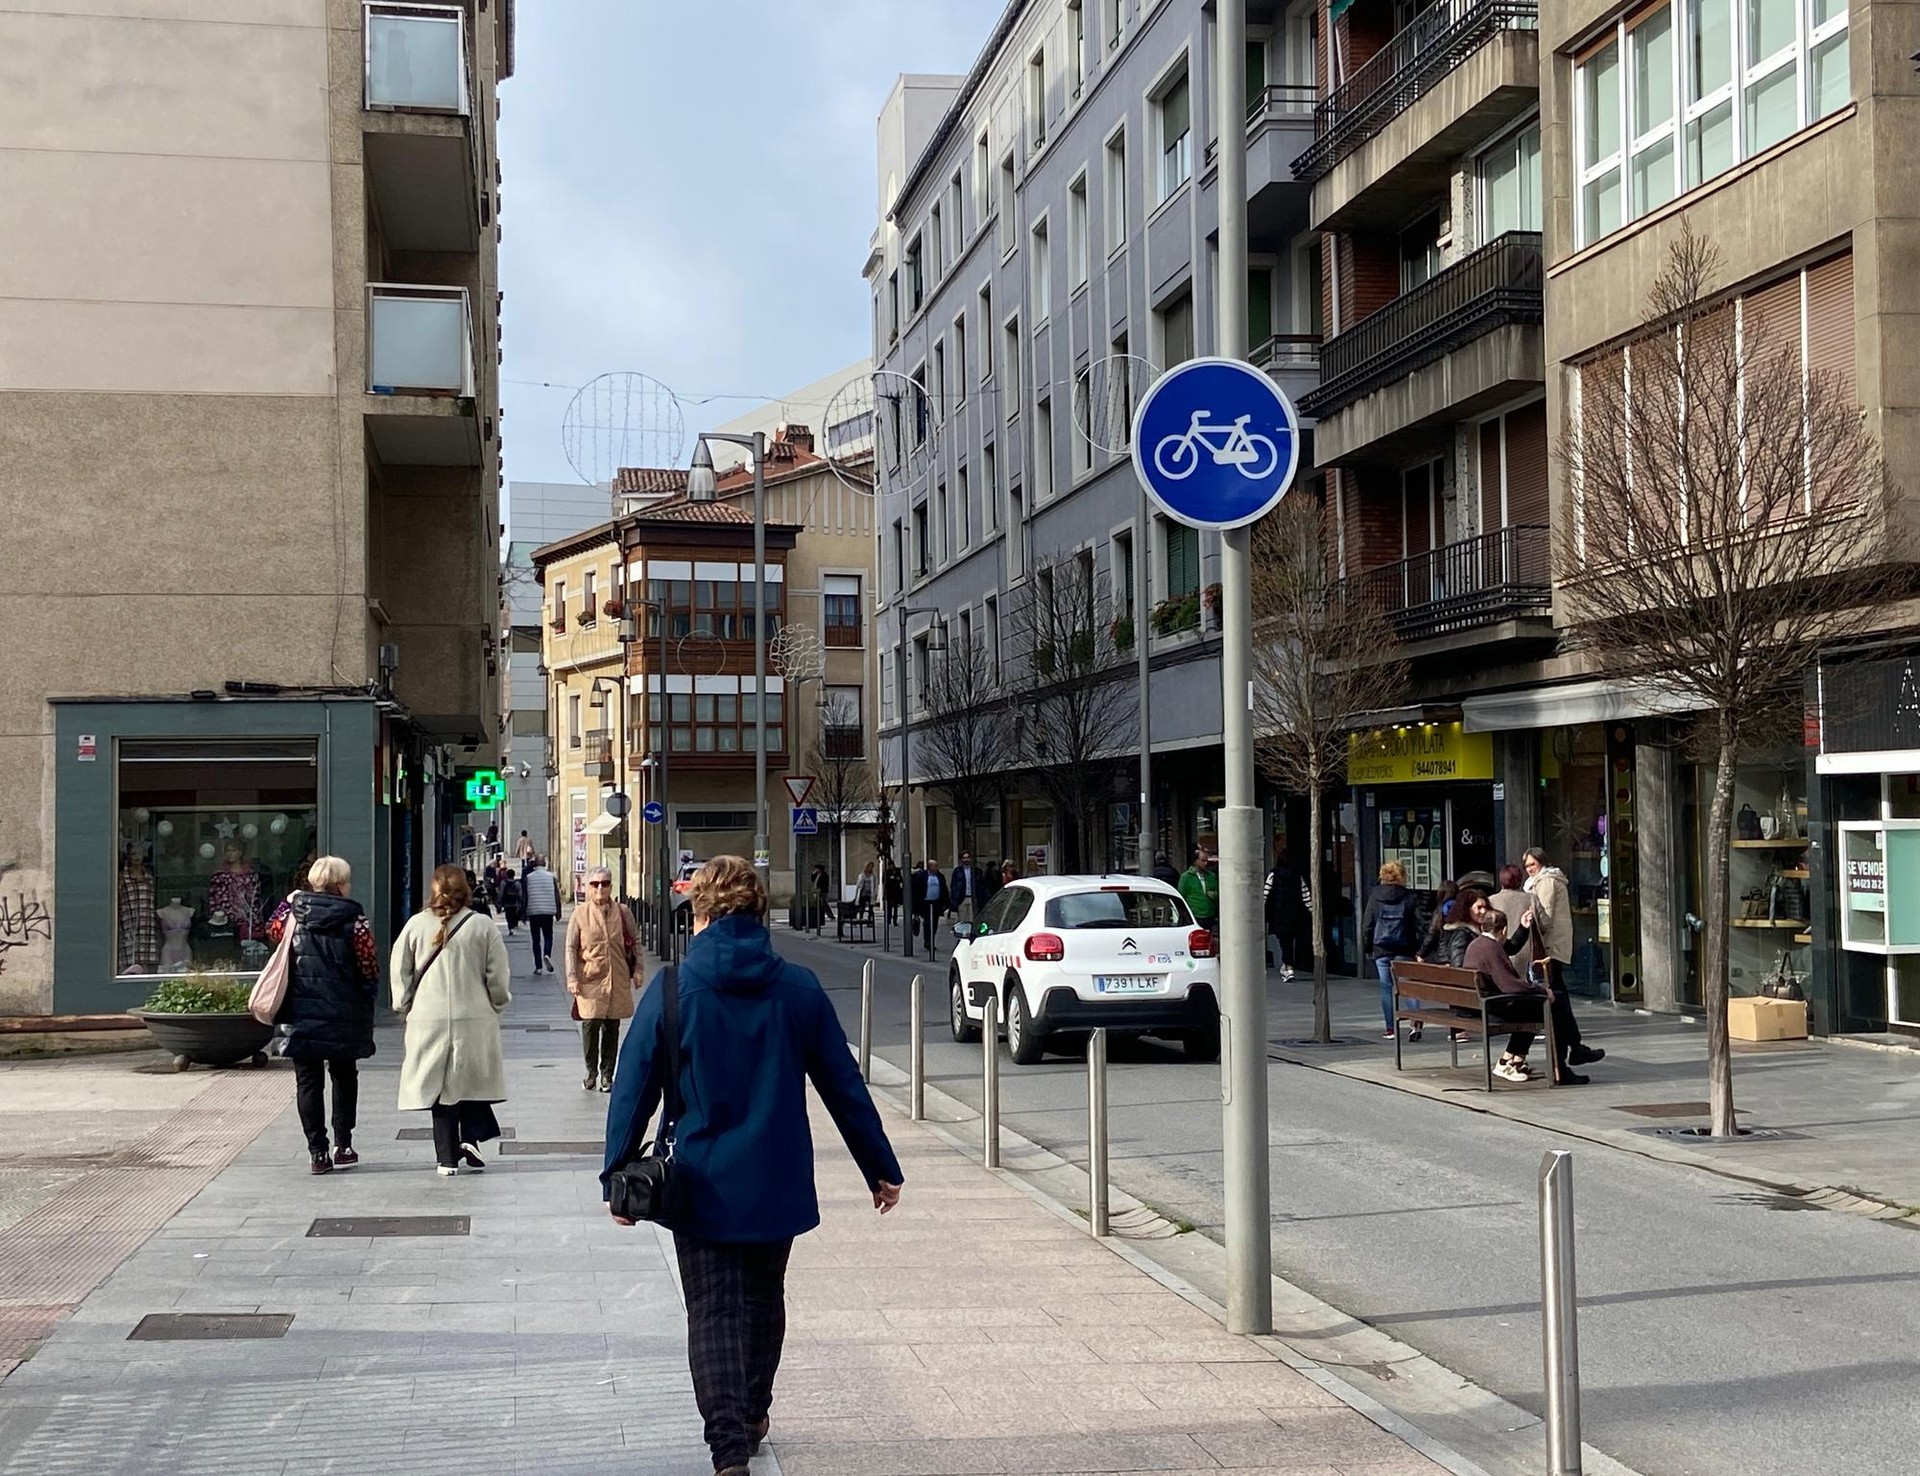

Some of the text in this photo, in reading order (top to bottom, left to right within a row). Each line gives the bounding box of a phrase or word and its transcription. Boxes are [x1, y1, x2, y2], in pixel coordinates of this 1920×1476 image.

[1418, 732, 1445, 755] PLATA
[1460, 828, 1474, 845] &
[1848, 861, 1884, 876] SE VENDE
[1106, 977, 1158, 989] 7391 LXF
